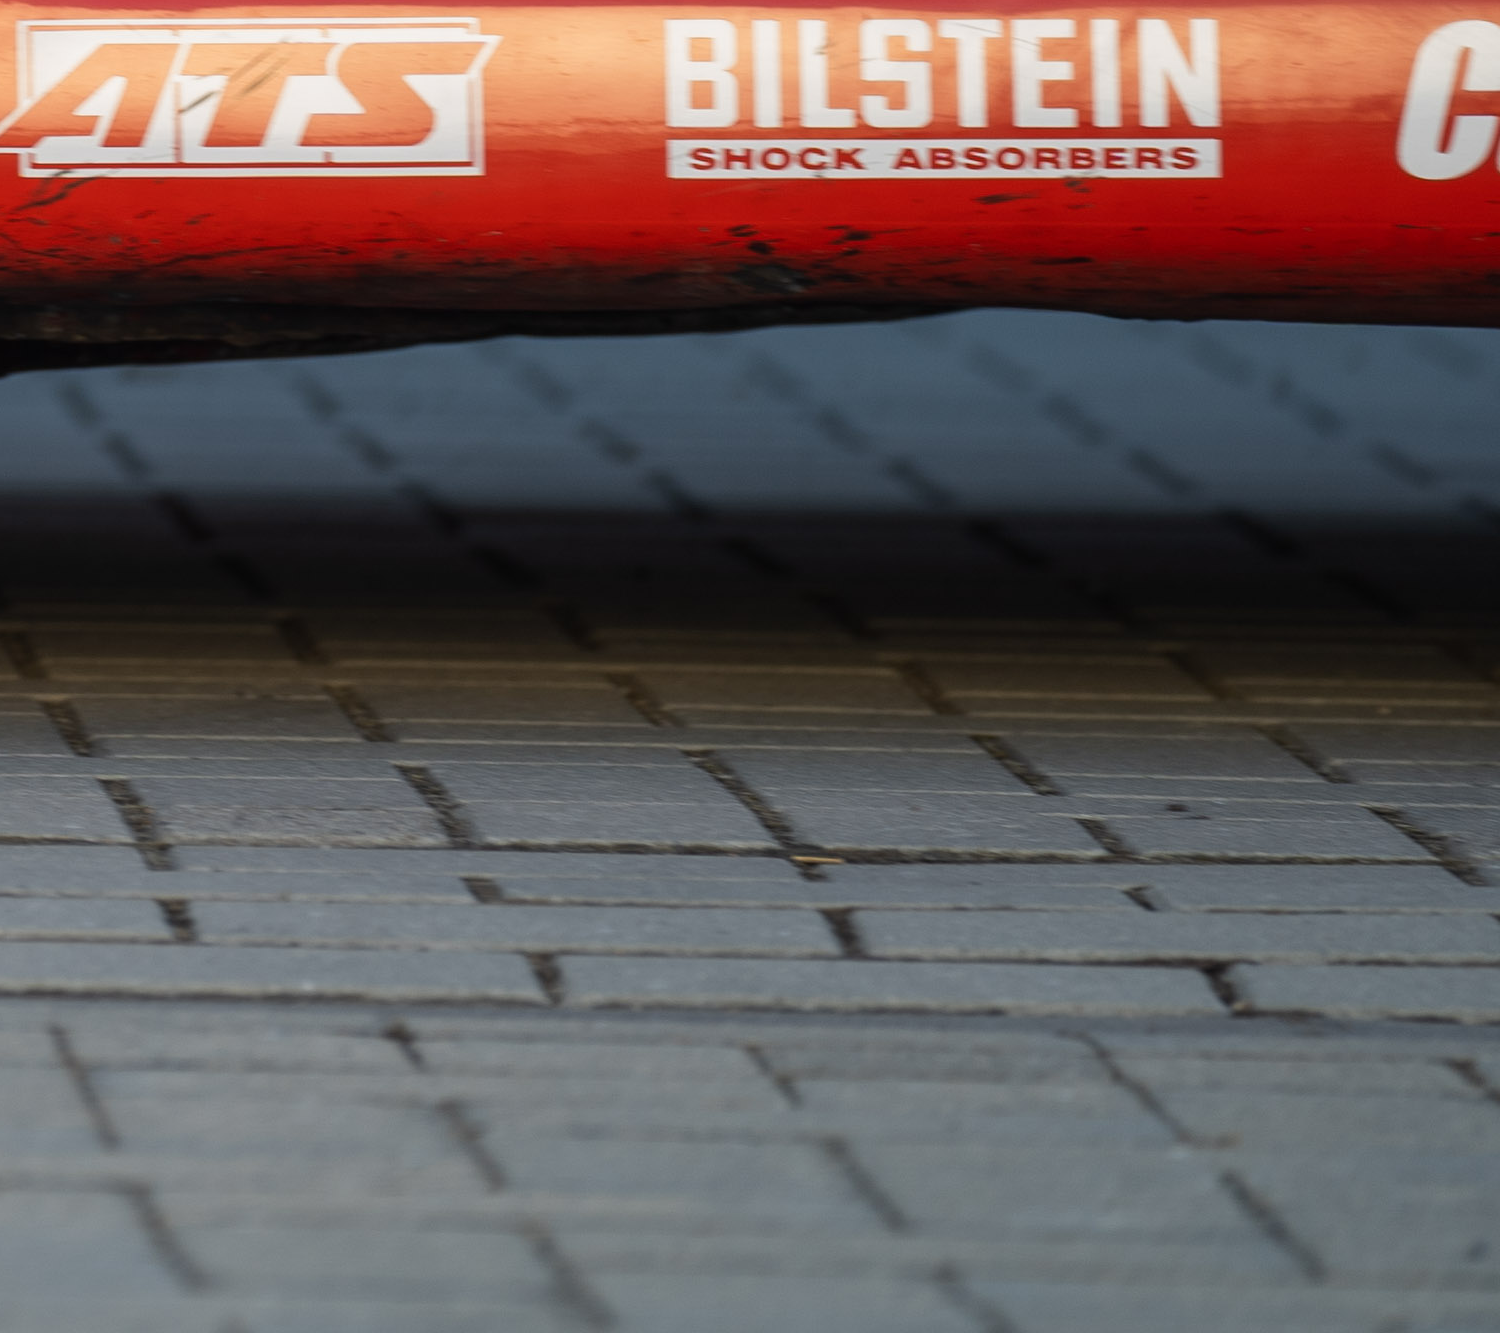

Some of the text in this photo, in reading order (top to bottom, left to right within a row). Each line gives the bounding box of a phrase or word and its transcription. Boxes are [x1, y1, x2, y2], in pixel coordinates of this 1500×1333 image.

[664, 19, 1221, 128] BILSTEIN
[1396, 19, 1500, 181] C
[690, 147, 1201, 171] SHOCK ABSORBERS
